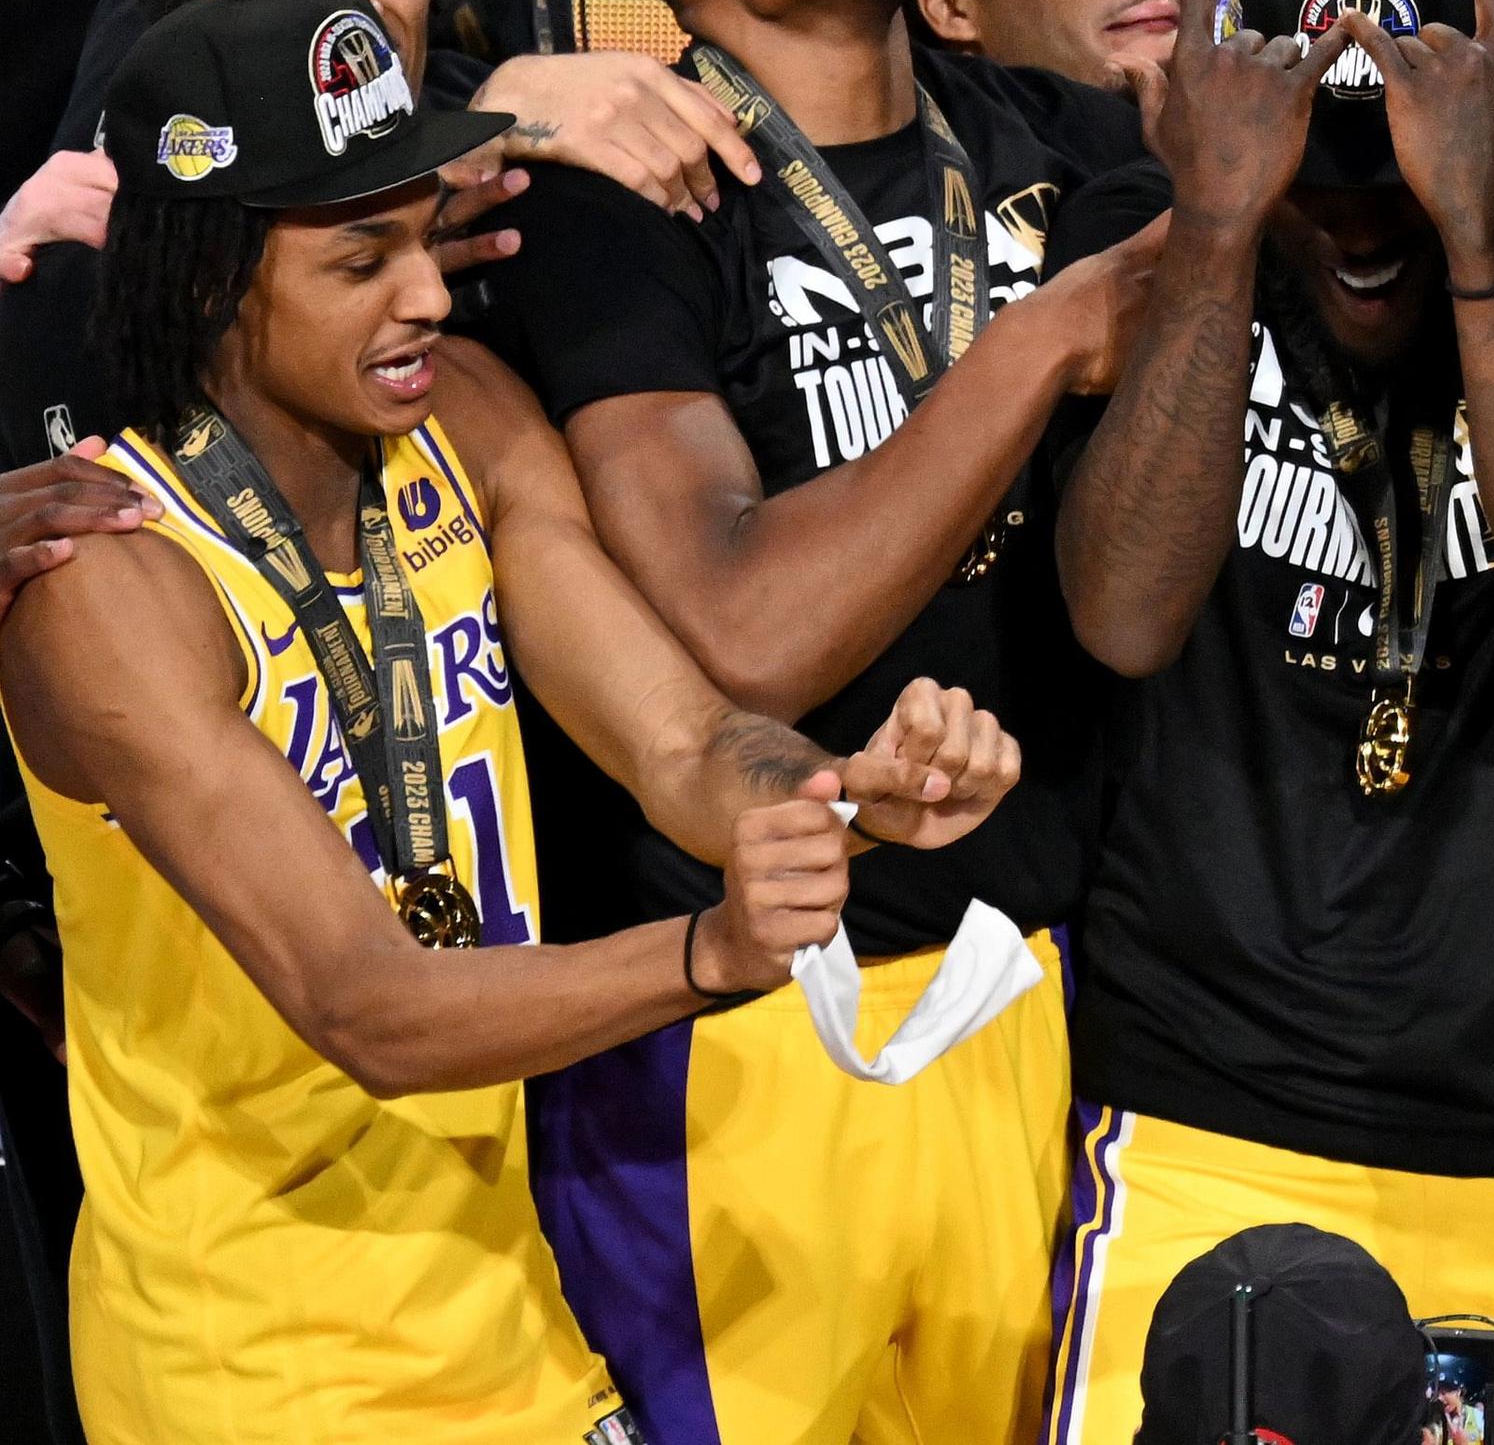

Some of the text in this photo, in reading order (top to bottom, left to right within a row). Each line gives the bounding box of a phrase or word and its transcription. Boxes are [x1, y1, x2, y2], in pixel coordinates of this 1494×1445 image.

[777, 159, 860, 250] CHAMPIONS
[844, 241, 889, 293] 2023
[950, 252, 975, 301] 2023
[403, 514, 475, 573] bibig
[363, 529, 410, 620] TOURNAMENT
[317, 619, 372, 714] TOURNAMENT
[1284, 650, 1337, 670] LAS
[401, 760, 428, 806] 2023
